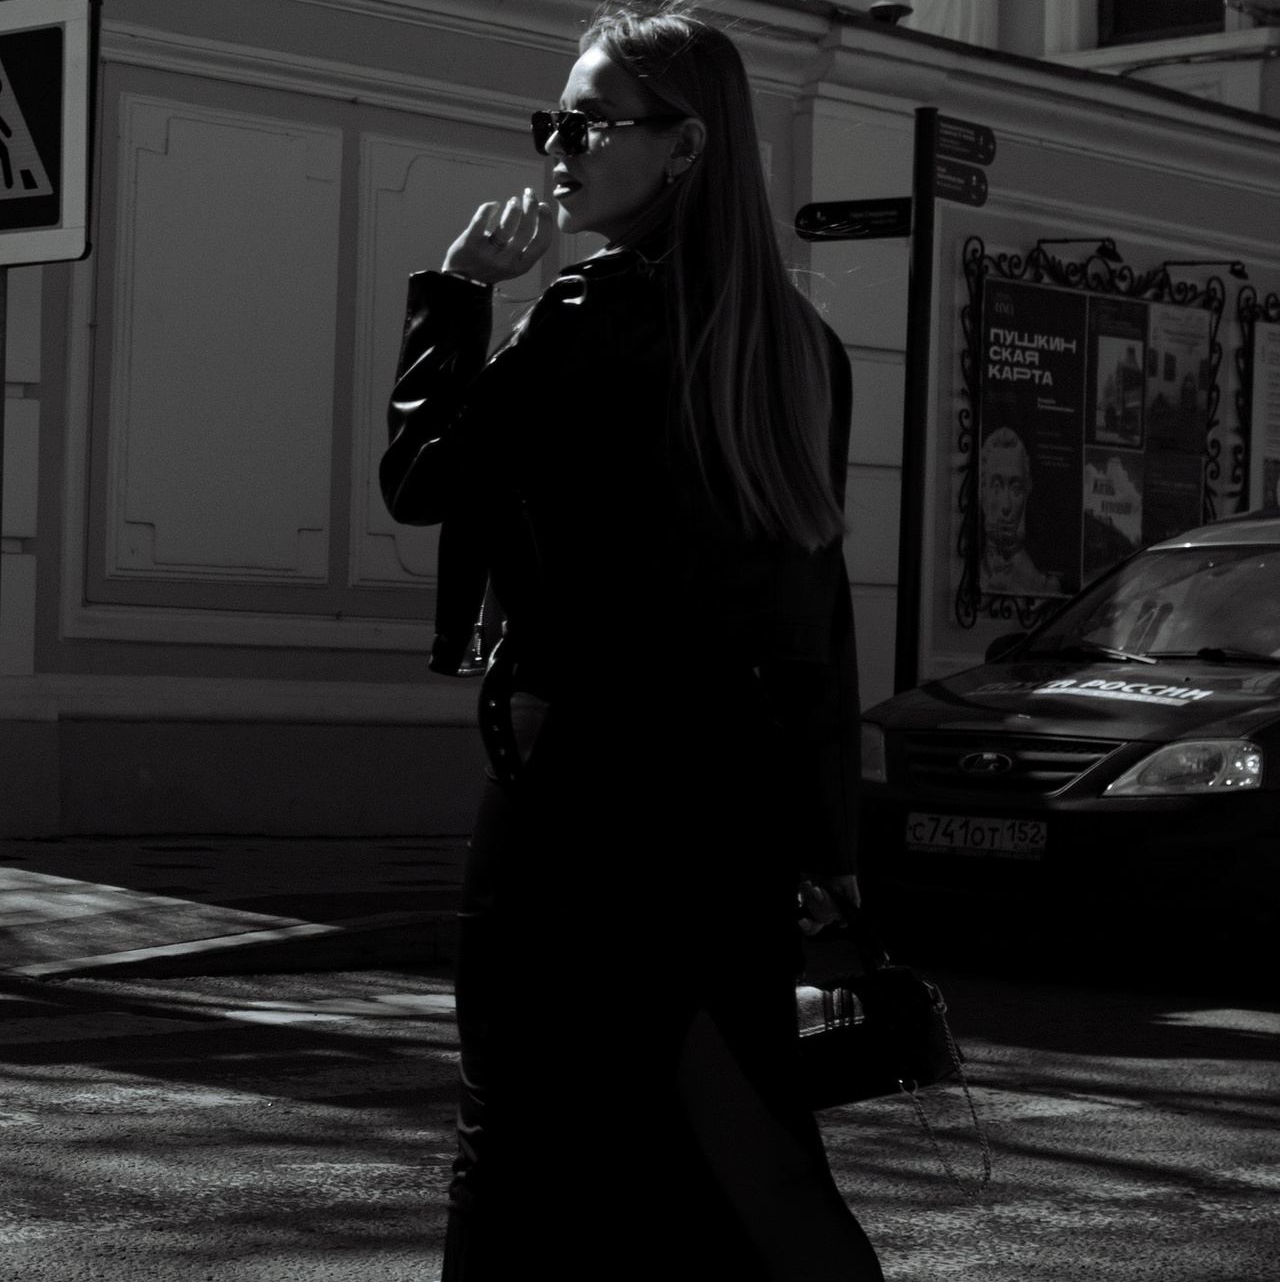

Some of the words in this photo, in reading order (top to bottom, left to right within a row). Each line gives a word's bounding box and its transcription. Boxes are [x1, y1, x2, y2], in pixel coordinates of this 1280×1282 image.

[990, 328, 1077, 354] ПУШКИН
[989, 346, 1039, 366] СКАЯ
[988, 364, 1053, 386] КАРТА
[1080, 679, 1213, 701] РОССИИ
[1006, 822, 1041, 844] 152
